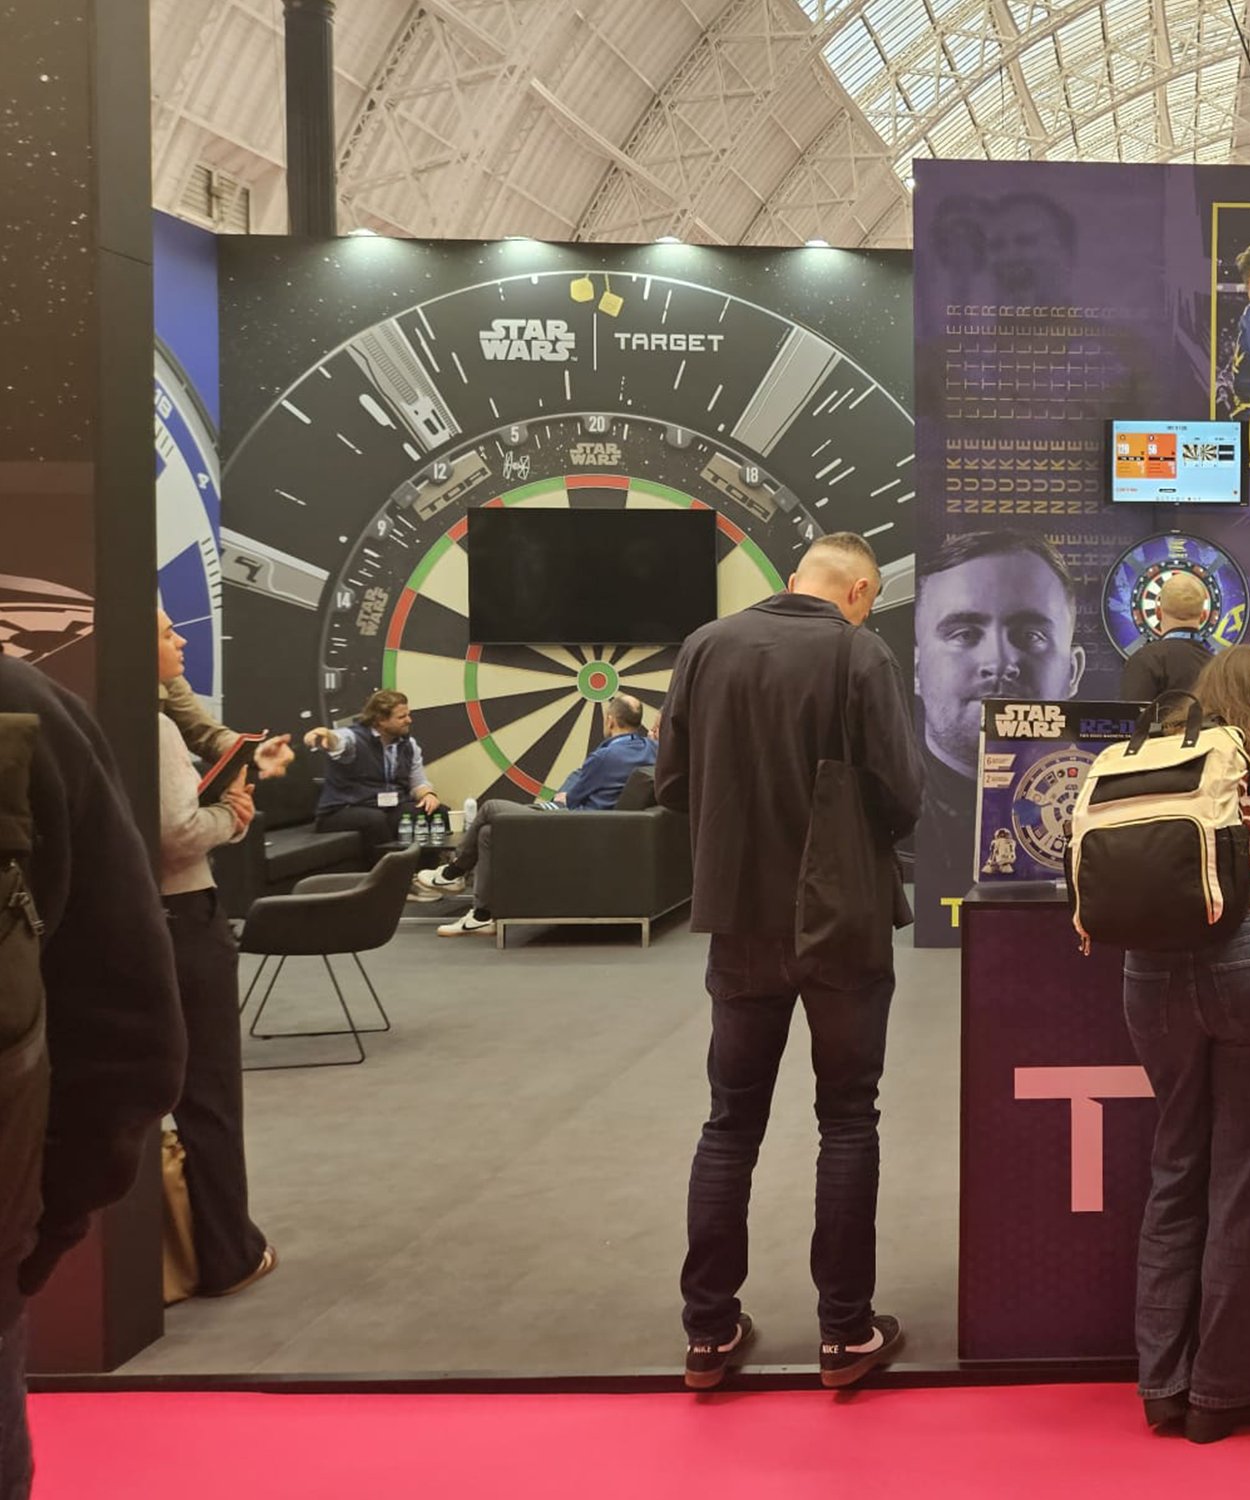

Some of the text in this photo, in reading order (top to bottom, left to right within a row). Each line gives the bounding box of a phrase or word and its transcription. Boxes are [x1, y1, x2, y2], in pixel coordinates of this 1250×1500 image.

[479, 319, 576, 340] STAR
[480, 340, 576, 361] WARS
[613, 333, 724, 351] TARGET
[1066, 306, 1082, 420] LITTLER
[946, 304, 962, 513] NUKE LITTLER
[963, 304, 979, 513] NUKE LITTLER
[980, 304, 996, 513] NUKE LITTLER
[998, 304, 1014, 513] NUKE LITTLER
[1015, 305, 1031, 514] NUKE LITTLER
[1032, 305, 1048, 514] NUKE LITTLER
[1049, 305, 1065, 514] NUKE LITTLER
[588, 416, 606, 433] 20
[510, 426, 520, 443] 5
[569, 442, 621, 455] STAR
[569, 453, 621, 466] WARS
[433, 462, 447, 480] 12
[745, 466, 759, 483] 18
[1066, 439, 1082, 514] NUKE
[1084, 439, 1099, 514] NUKE
[196, 472, 210, 489] 4
[377, 520, 387, 536] 9
[805, 523, 814, 540] 4
[336, 592, 351, 609] 14
[325, 672, 337, 689] 11
[995, 704, 1066, 721] STAR
[995, 720, 1066, 738] WARS
[1080, 718, 1136, 734] R2-D
[822, 1344, 839, 1354] NIKE
